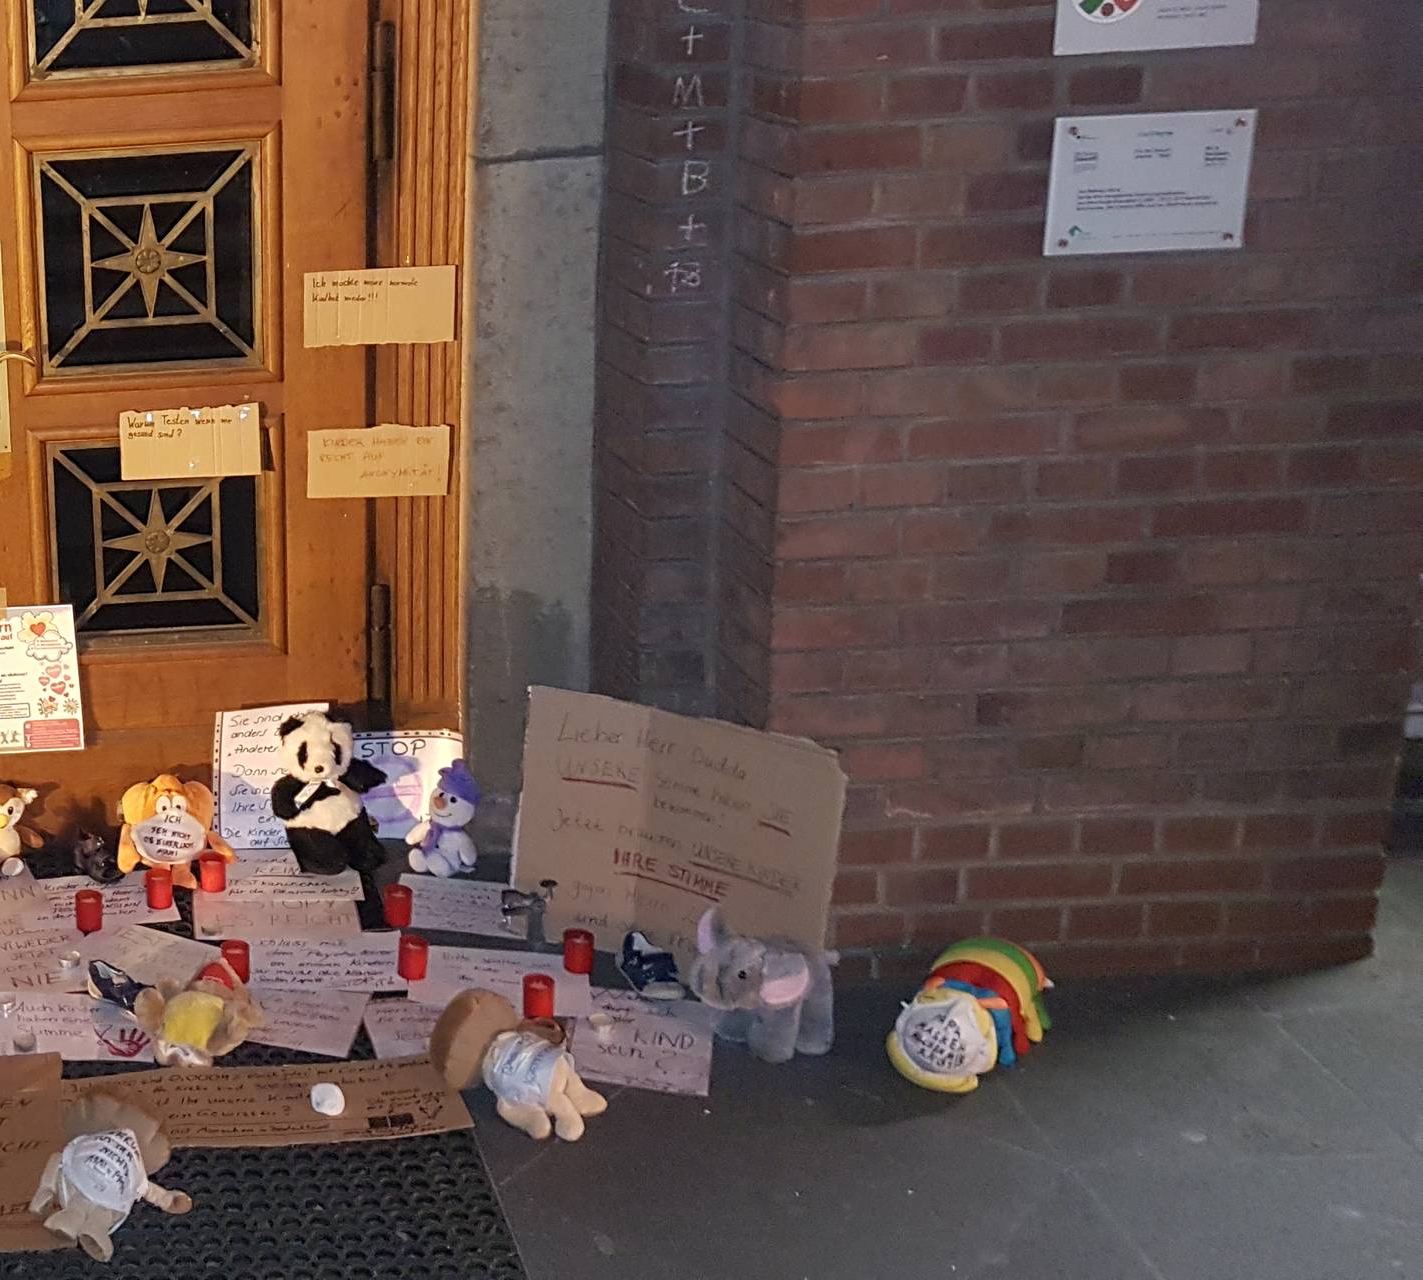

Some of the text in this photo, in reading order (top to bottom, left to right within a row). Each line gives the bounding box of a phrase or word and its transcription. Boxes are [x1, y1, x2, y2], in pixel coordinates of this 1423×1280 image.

[312, 278, 326, 288] Ich
[161, 415, 190, 425] Testen
[361, 738, 426, 759] STOP
[232, 764, 267, 777] Dann
[165, 815, 182, 823] ICH
[613, 847, 728, 897] IHRE STIMME
[10, 973, 60, 988] NIE
[633, 1028, 694, 1050] KIND
